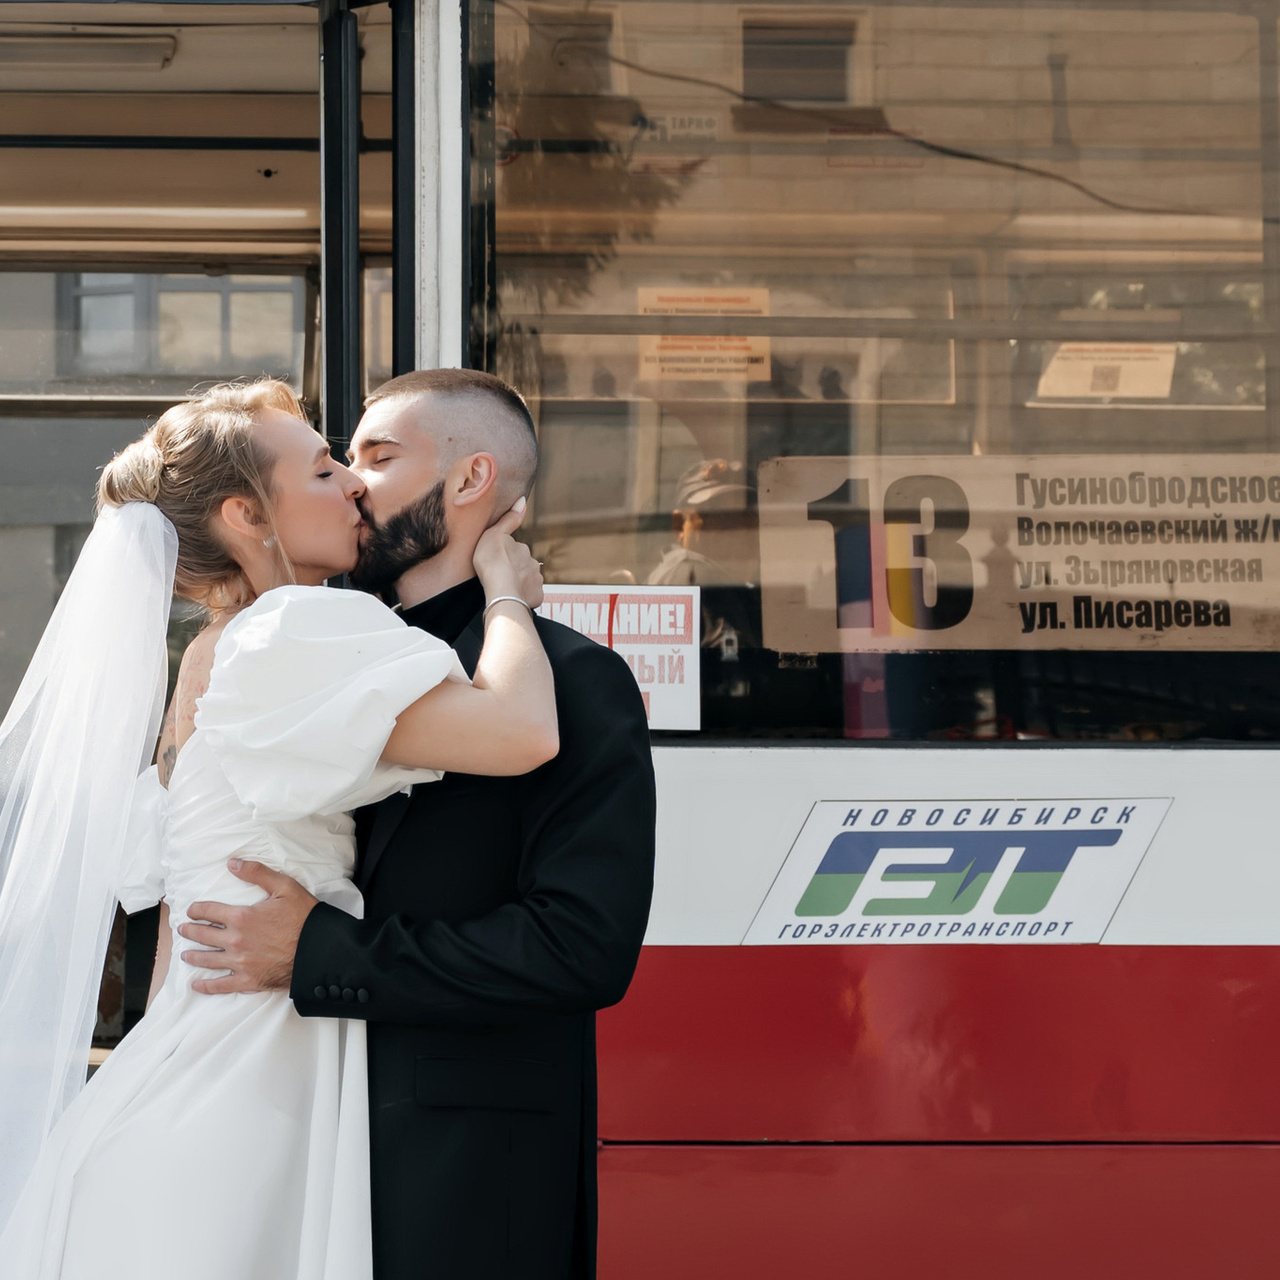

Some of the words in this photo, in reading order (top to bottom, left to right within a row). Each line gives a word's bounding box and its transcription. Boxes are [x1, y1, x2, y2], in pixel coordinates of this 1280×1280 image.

[1015, 471, 1280, 508] Гусинобродское
[1017, 513, 1228, 547] Волочаевский
[807, 474, 974, 630] 13
[1018, 560, 1059, 589] ул.
[1066, 555, 1264, 588] Зыряновская
[534, 603, 685, 635] ИМАНИЕ!
[1019, 601, 1066, 633] ул.
[1073, 596, 1231, 632] Писарева
[842, 806, 1136, 826] НОВОСИБИРСК
[778, 921, 1075, 939] ГОРЭЛЕКТРОТРАНСПОРТ
